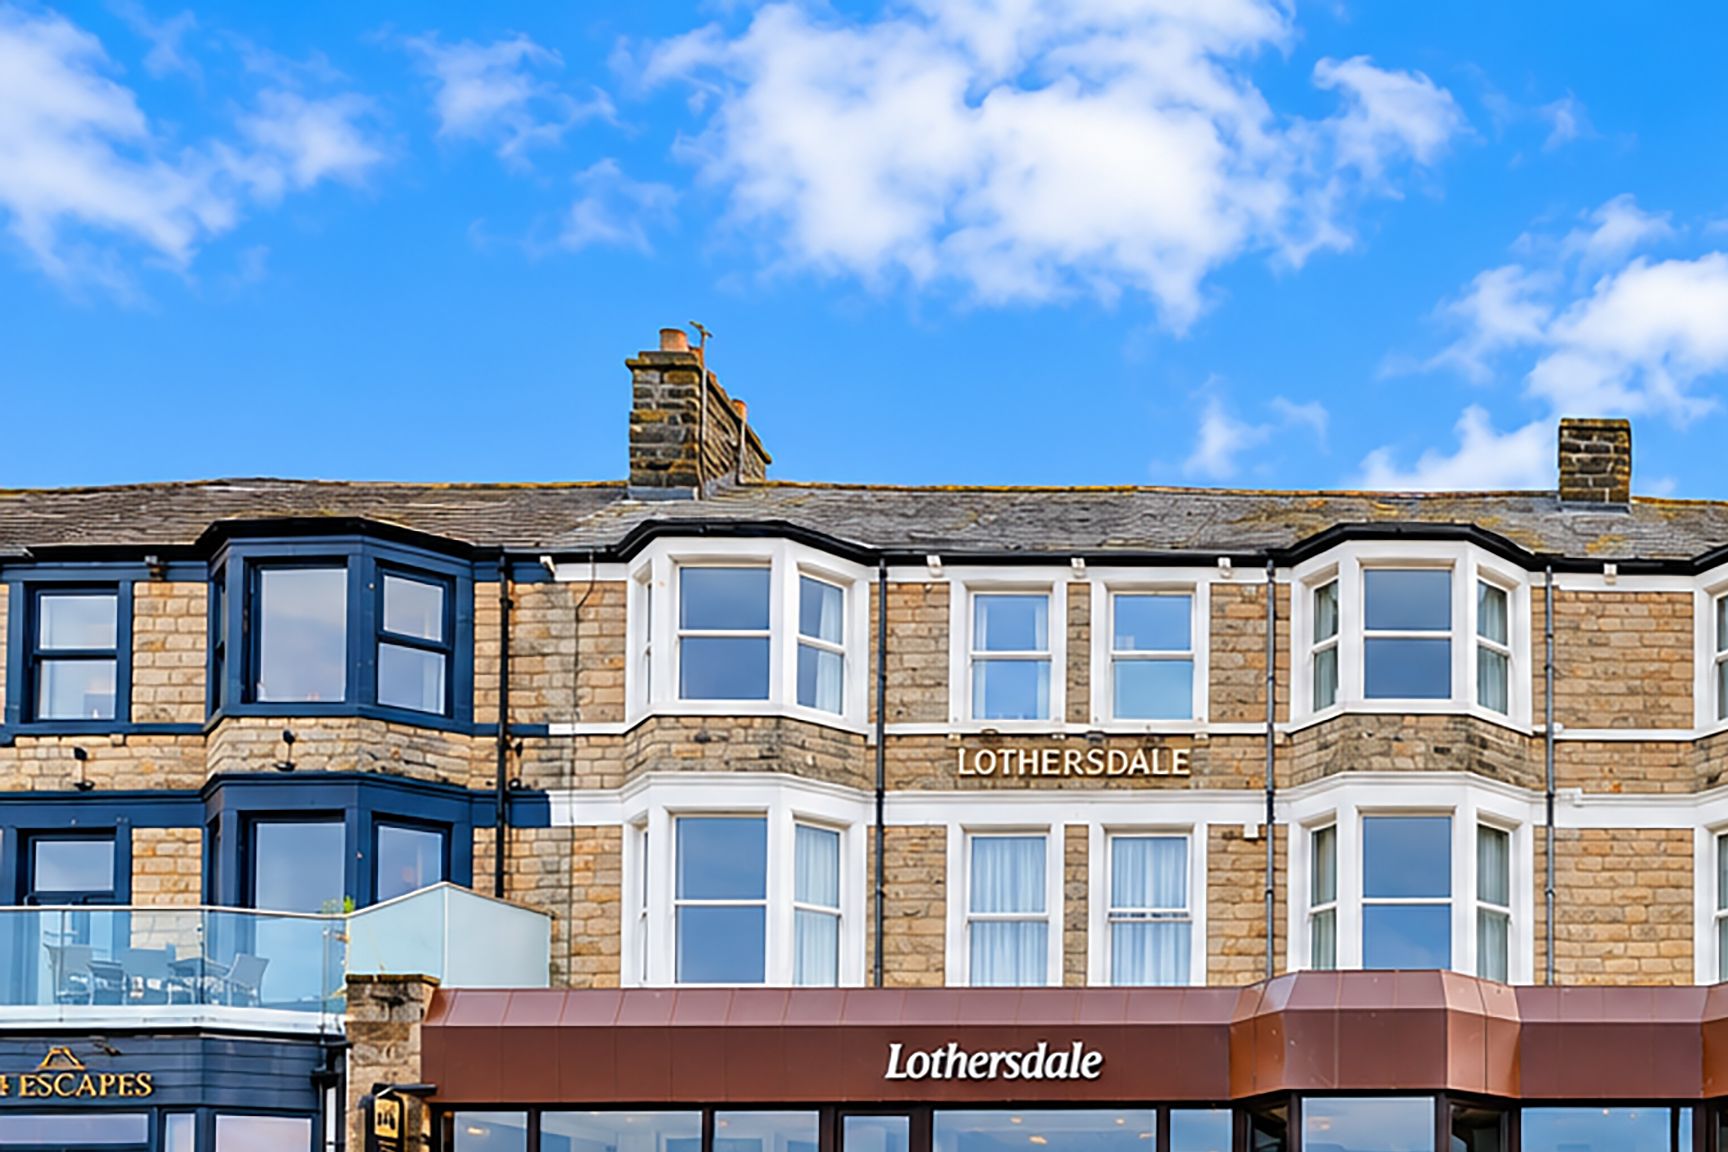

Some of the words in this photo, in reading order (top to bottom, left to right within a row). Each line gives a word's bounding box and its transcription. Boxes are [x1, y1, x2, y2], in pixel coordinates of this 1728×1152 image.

[958, 748, 1191, 775] LOTHERSDALE
[885, 1042, 1103, 1079] Lothersdale
[19, 1073, 152, 1097] ESCAPES
